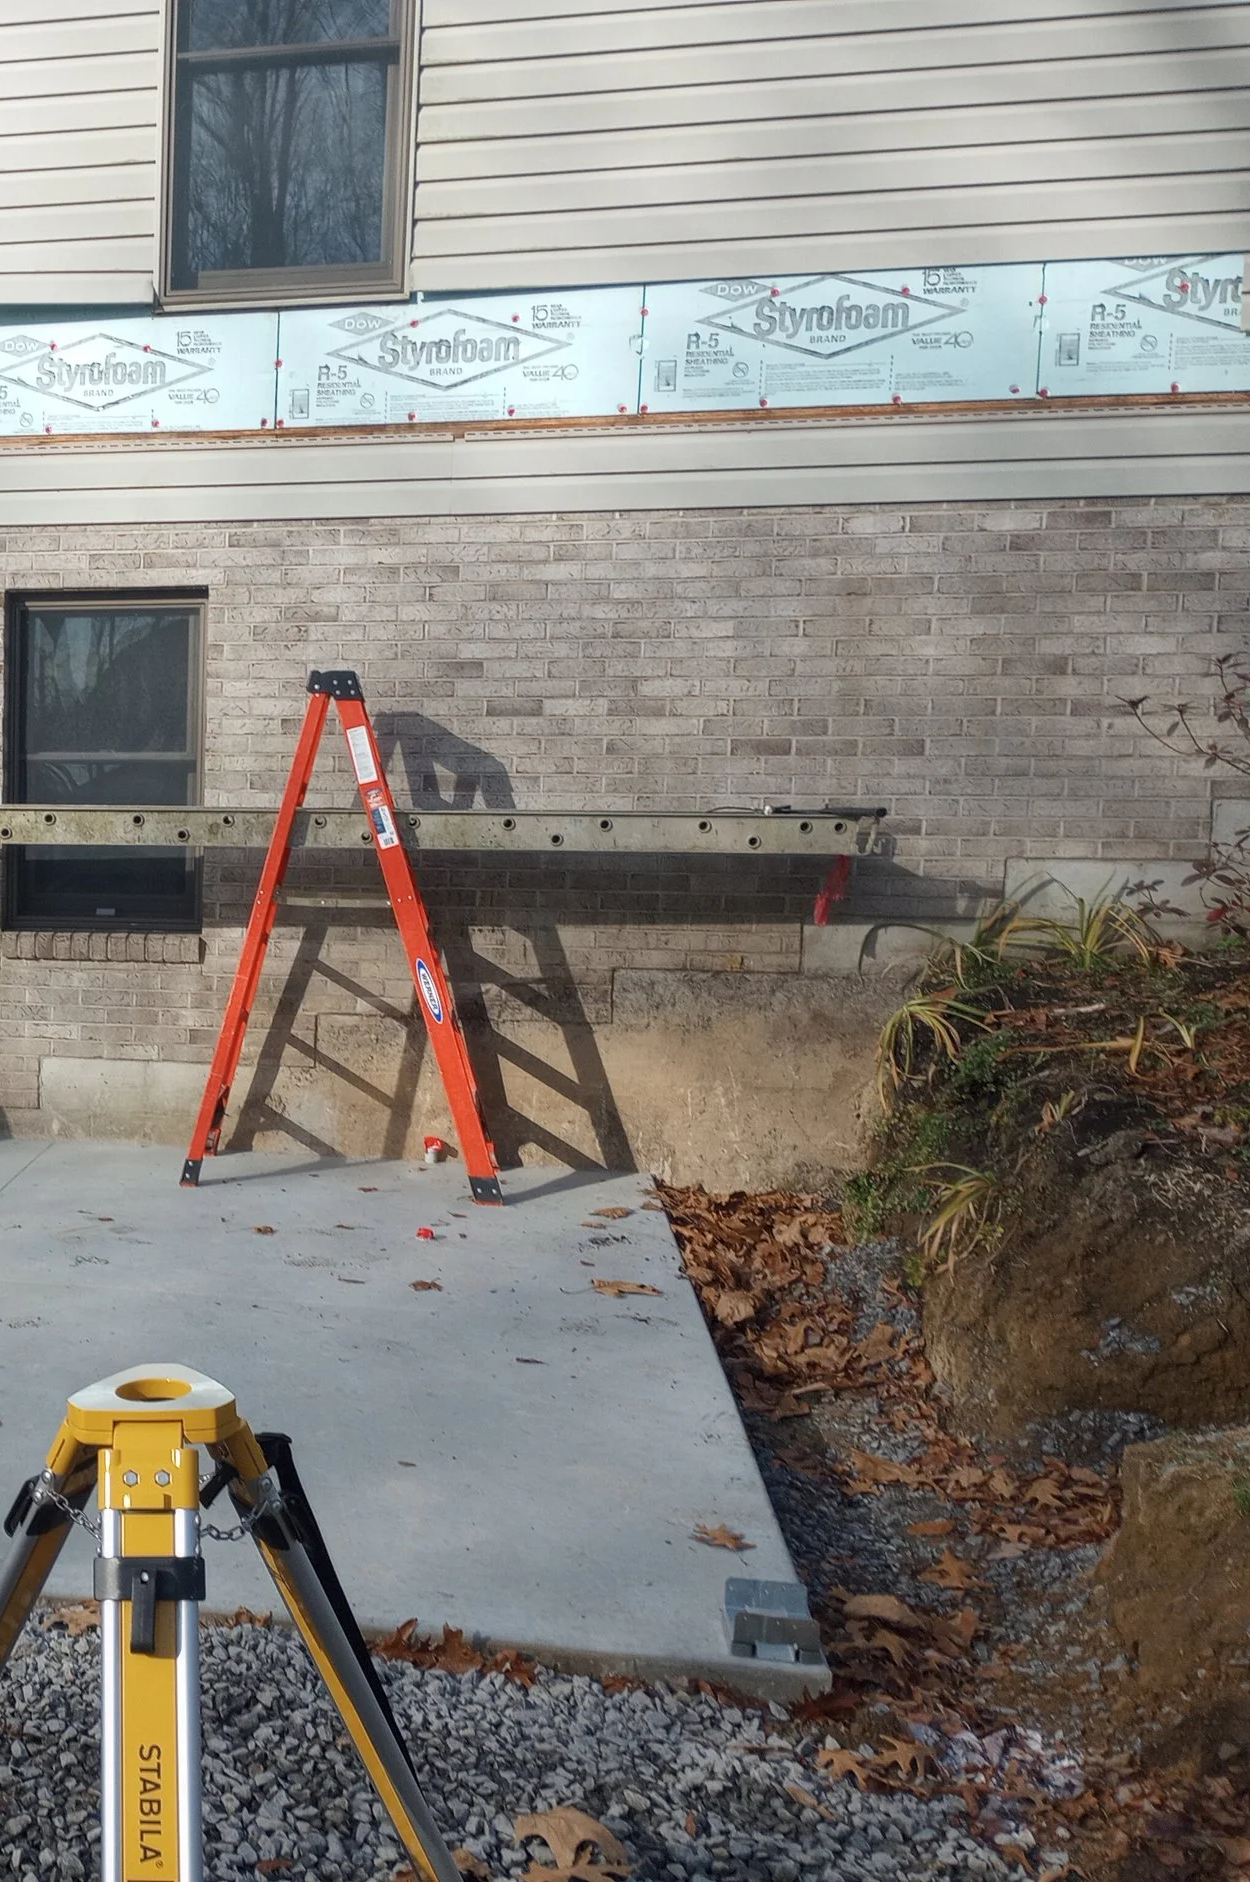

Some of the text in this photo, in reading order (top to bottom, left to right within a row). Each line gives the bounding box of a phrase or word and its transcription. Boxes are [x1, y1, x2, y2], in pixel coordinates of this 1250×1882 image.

[922, 268, 941, 286] 15
[717, 284, 757, 296] DOW
[922, 286, 976, 295] WARRANTY
[531, 305, 549, 321] 15
[753, 294, 910, 339] Styrofoam
[1091, 302, 1126, 321] R-5
[1223, 308, 1241, 316] BR
[344, 319, 381, 330] DOW
[531, 321, 581, 329] WARRANTY
[1089, 321, 1142, 330] RESIDENTIAL
[4, 341, 38, 351] DOW
[176, 331, 192, 347] 15
[687, 332, 719, 349] R-5
[809, 335, 846, 344] BRAND
[911, 331, 974, 349] VALUE 40
[176, 346, 222, 355] WARRANTY
[378, 329, 520, 371] Styrofoam
[686, 349, 734, 358] RESIDENTIAL
[36, 352, 167, 392] Styrofoam
[318, 364, 347, 381] R-5
[429, 367, 463, 376] BRAND
[552, 363, 579, 380] 40
[83, 389, 114, 397] BRAND
[196, 388, 220, 404] 40
[421, 972, 439, 1010] WERNER
[139, 1743, 162, 1863] STABILA
